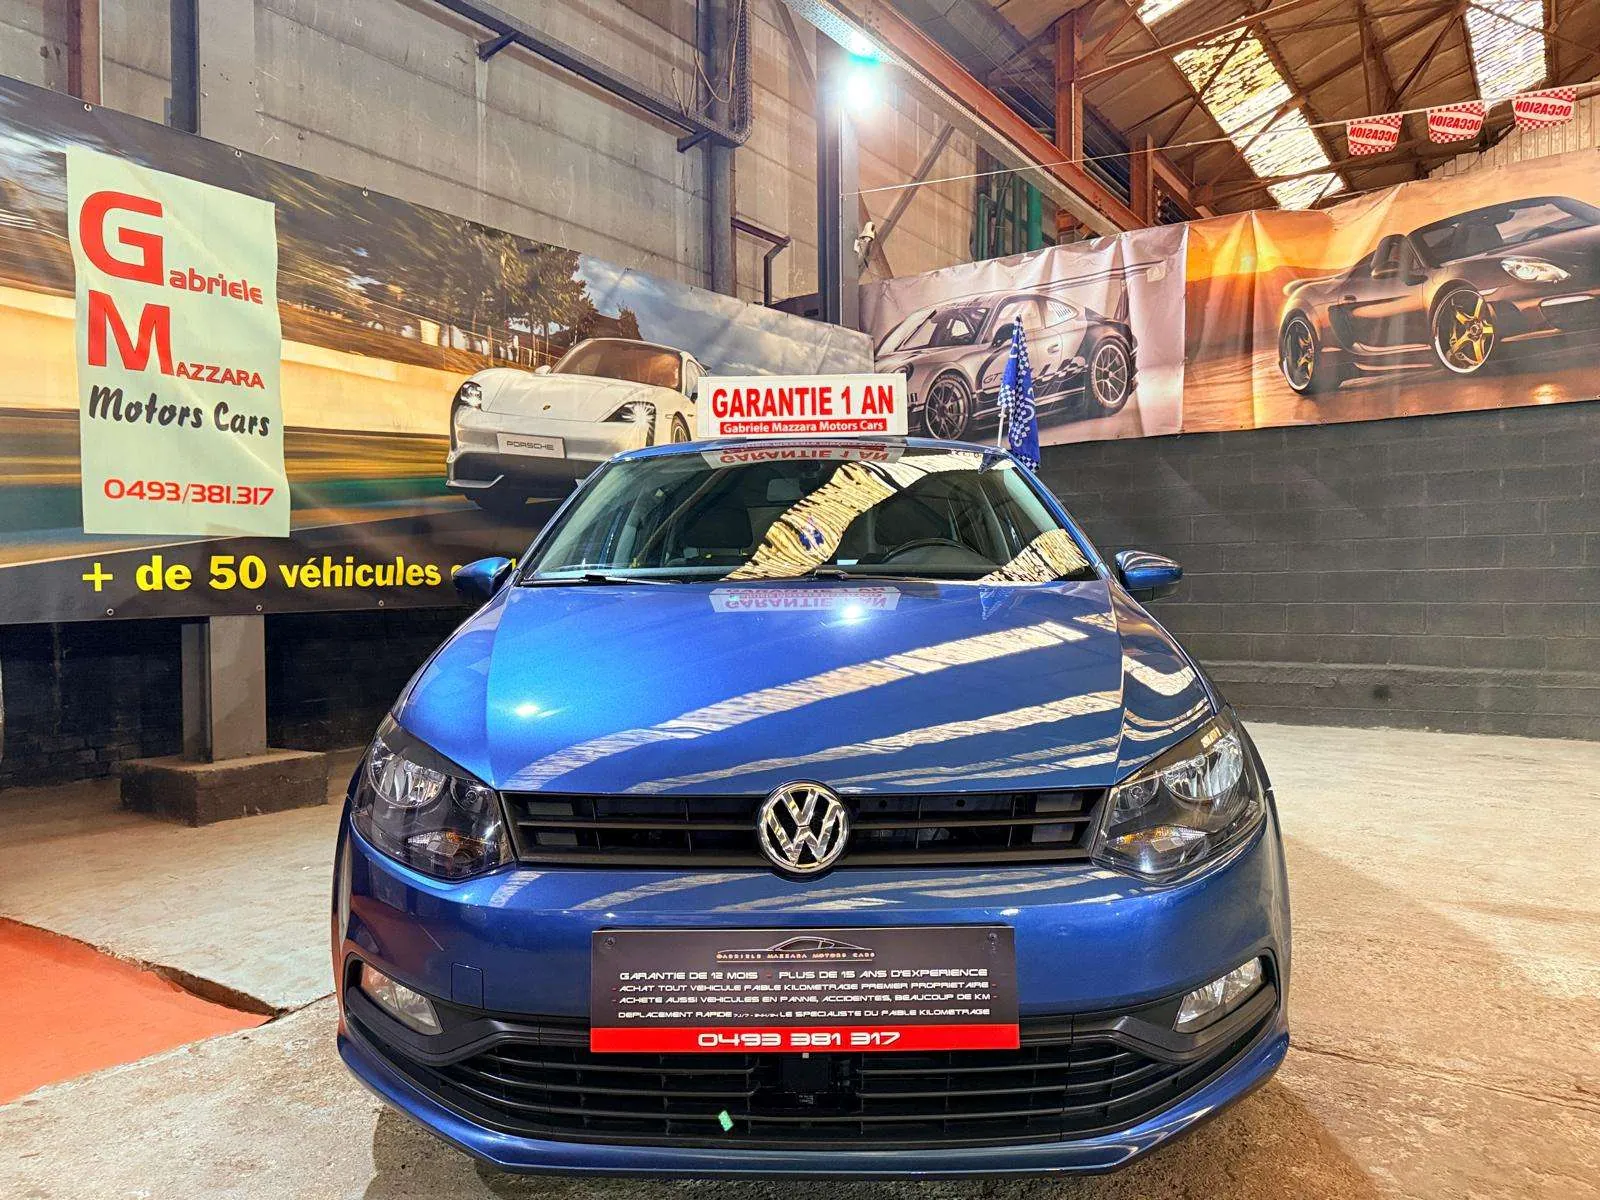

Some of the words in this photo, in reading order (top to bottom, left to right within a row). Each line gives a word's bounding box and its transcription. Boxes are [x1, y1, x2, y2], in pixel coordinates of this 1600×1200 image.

[712, 386, 832, 419] GARANTIE
[841, 386, 851, 415] 1
[861, 385, 894, 415] AN
[89, 384, 203, 429] Motors
[213, 401, 270, 437] Cars
[723, 422, 769, 434] Gabriele
[771, 421, 817, 433] Mazzara
[819, 420, 858, 432] Motors
[860, 419, 884, 431] Cars
[506, 440, 555, 451] PORSCHE
[104, 478, 275, 505] 0493/381.317
[82, 562, 113, 592] +
[136, 556, 192, 591] de
[209, 556, 267, 590] 50
[279, 556, 442, 588] véhicules
[619, 972, 685, 980] GARANTIE
[689, 972, 708, 980] DE
[726, 971, 758, 980] MOIS
[778, 971, 816, 979] PLUS
[818, 971, 838, 979] DE
[841, 970, 856, 978] 15
[859, 970, 888, 978] ANS
[890, 969, 988, 978] D'EXPERIENCE
[784, 983, 859, 991] KILOMETRAGE
[861, 982, 909, 990] PREMIER
[911, 981, 989, 989] PROPRIETAIRE
[619, 996, 663, 1004] ACHETE
[780, 995, 819, 1003] PANNE,
[957, 993, 972, 1001] DE
[618, 1011, 694, 1019] DEPLACEMENT
[795, 1010, 862, 1018] SPECIALISTE
[919, 1008, 991, 1016] KILOMETRAGE
[697, 1033, 782, 1047] 0493
[790, 1032, 842, 1046] 381
[850, 1031, 901, 1046] 317
